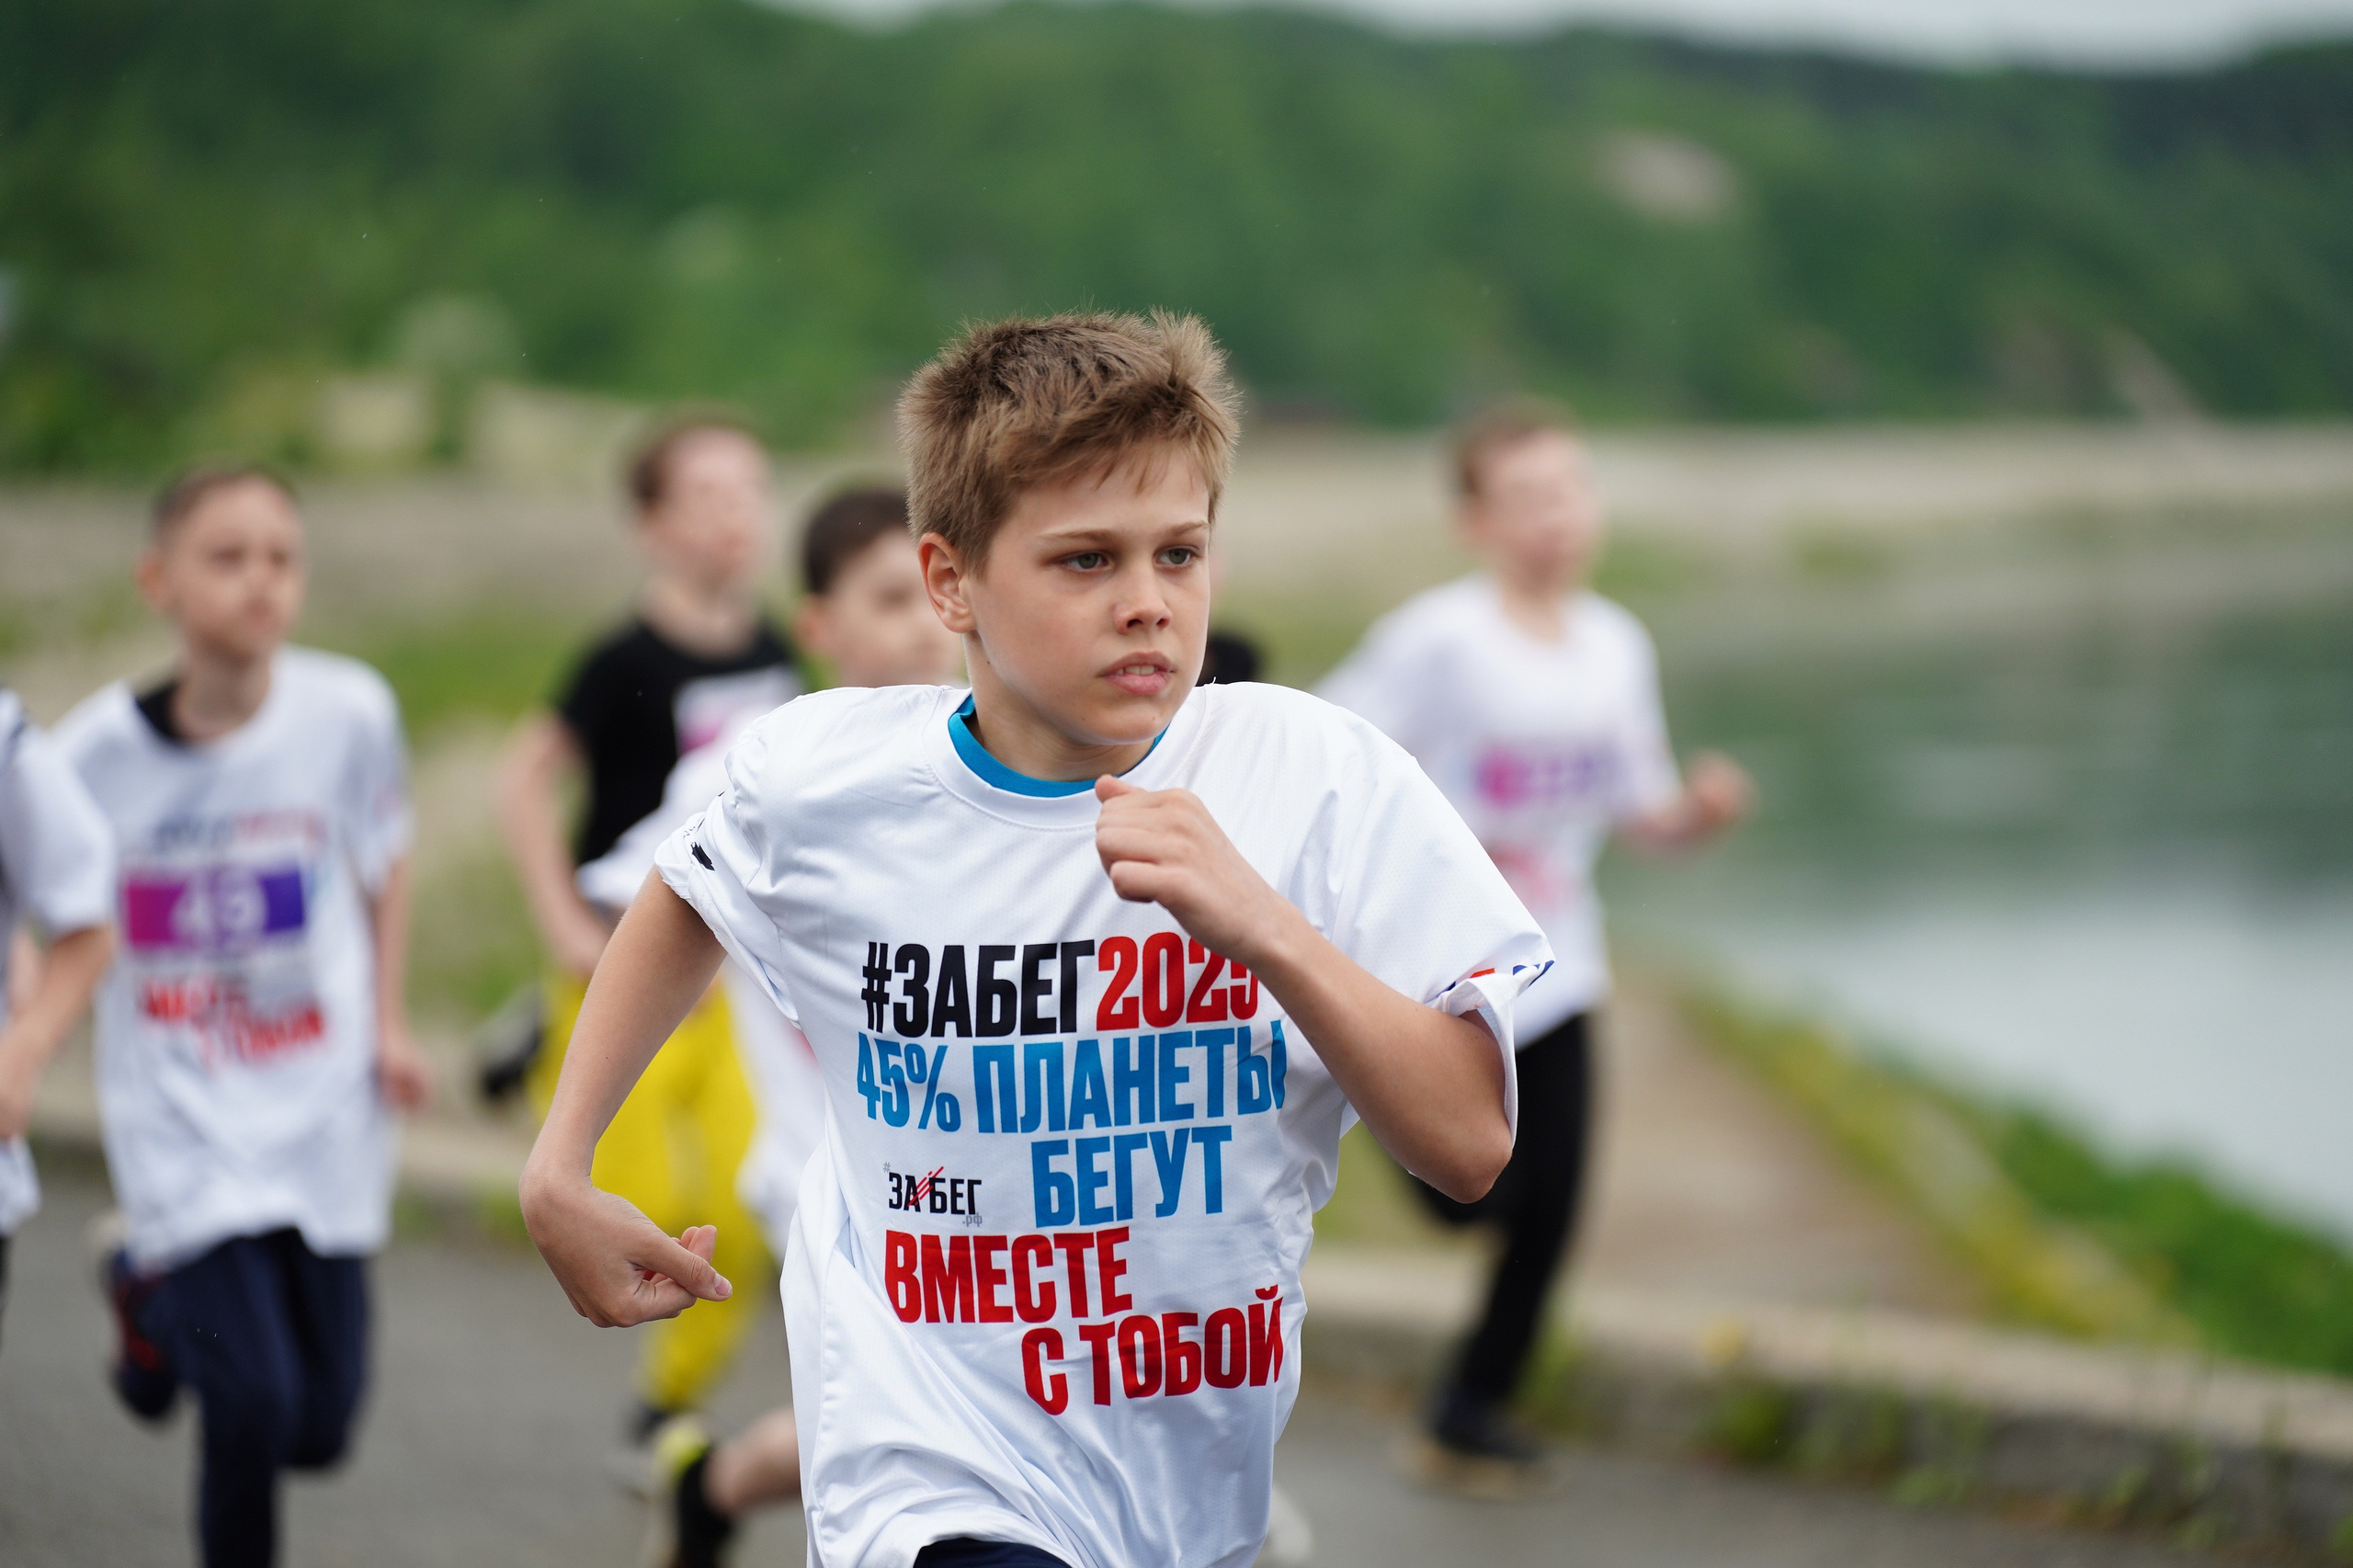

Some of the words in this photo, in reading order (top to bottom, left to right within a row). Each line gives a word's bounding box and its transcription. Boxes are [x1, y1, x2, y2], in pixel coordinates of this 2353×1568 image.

[857, 1031, 961, 1132] 45%
[972, 1020, 1288, 1133] ПЛАНЕТЫ
[1030, 1126, 1233, 1228] БЕГУТ
[885, 1227, 1133, 1324] ВМЕСТЕ
[1021, 1327, 1069, 1415] С
[1079, 1284, 1284, 1406] ТОБОЙ
